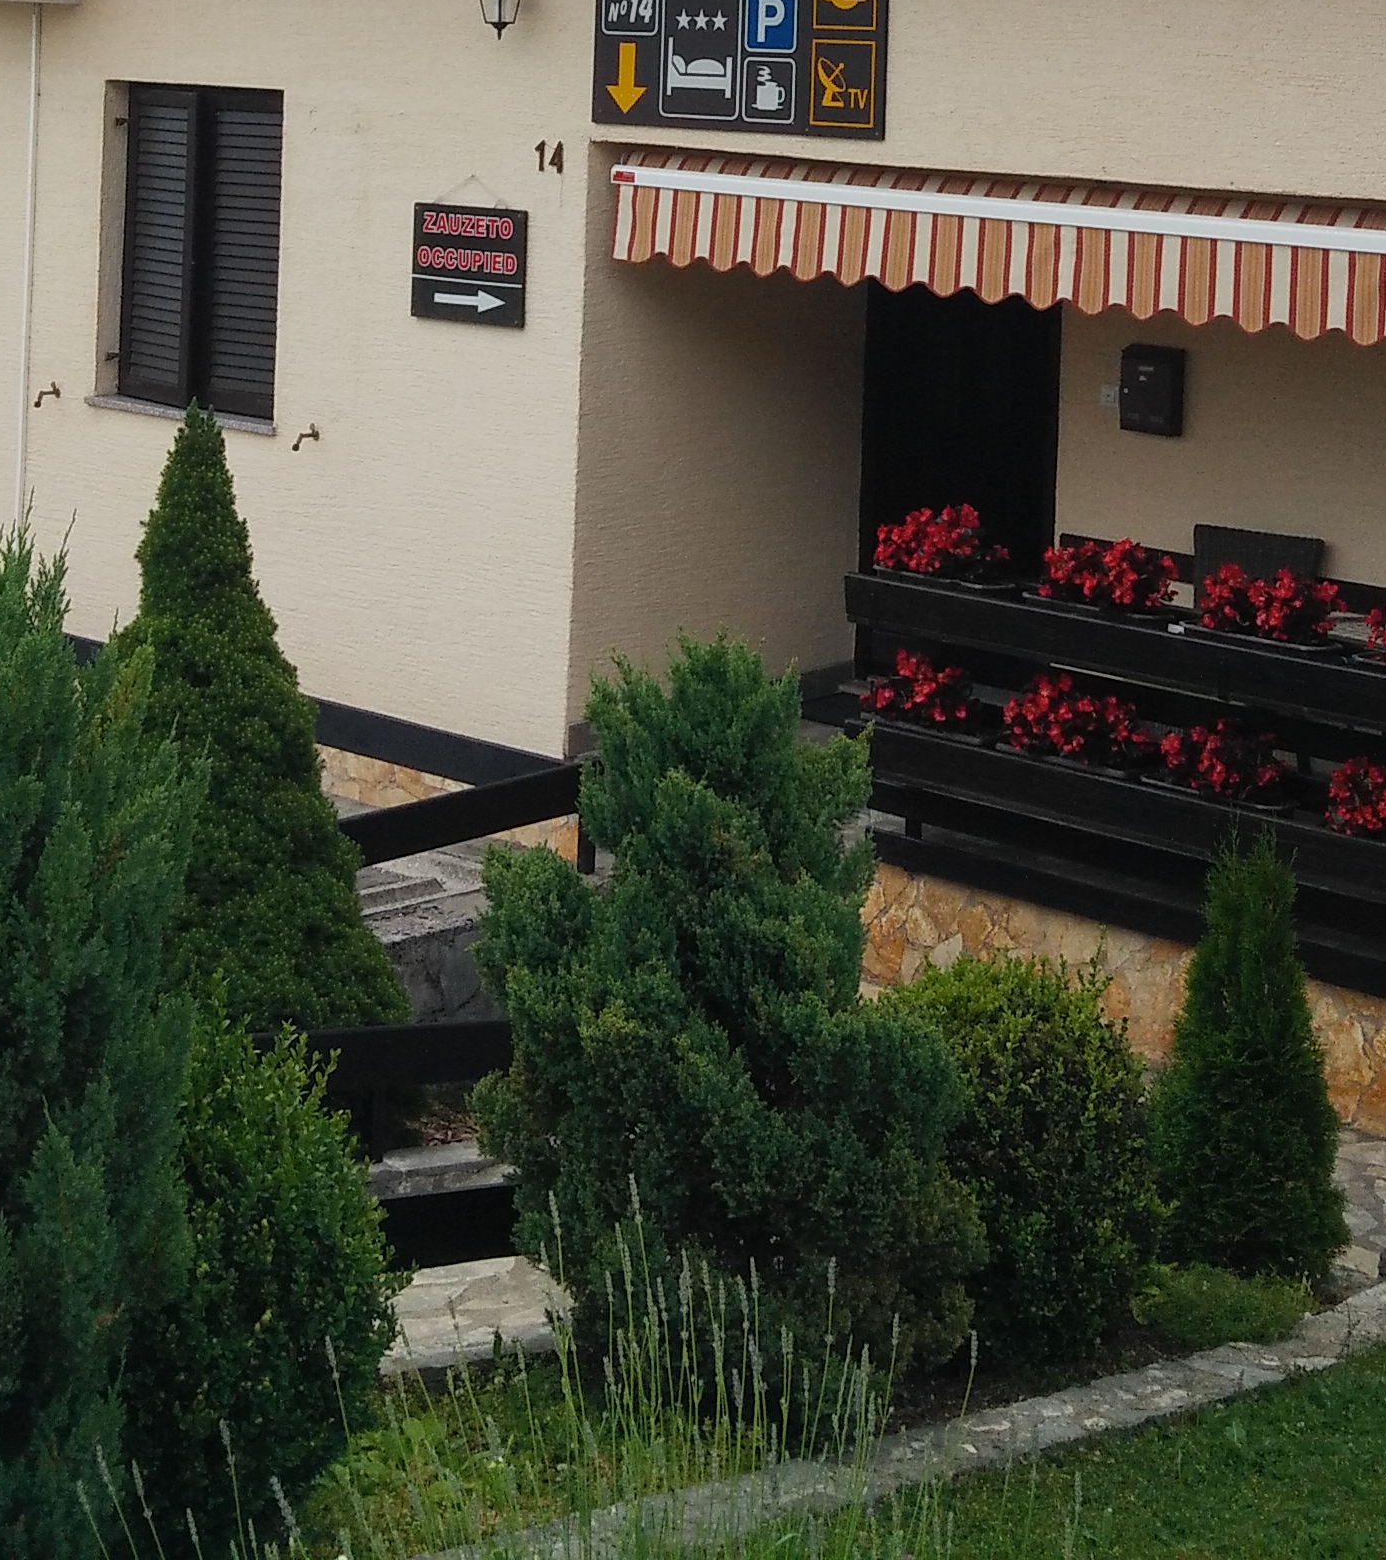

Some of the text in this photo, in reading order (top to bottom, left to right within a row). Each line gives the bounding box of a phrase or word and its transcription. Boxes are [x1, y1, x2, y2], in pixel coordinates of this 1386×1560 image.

[847, 88, 869, 109] TV
[534, 139, 564, 174] 14
[422, 211, 514, 240] ZAUZETO
[417, 245, 518, 275] OCCUPIED
